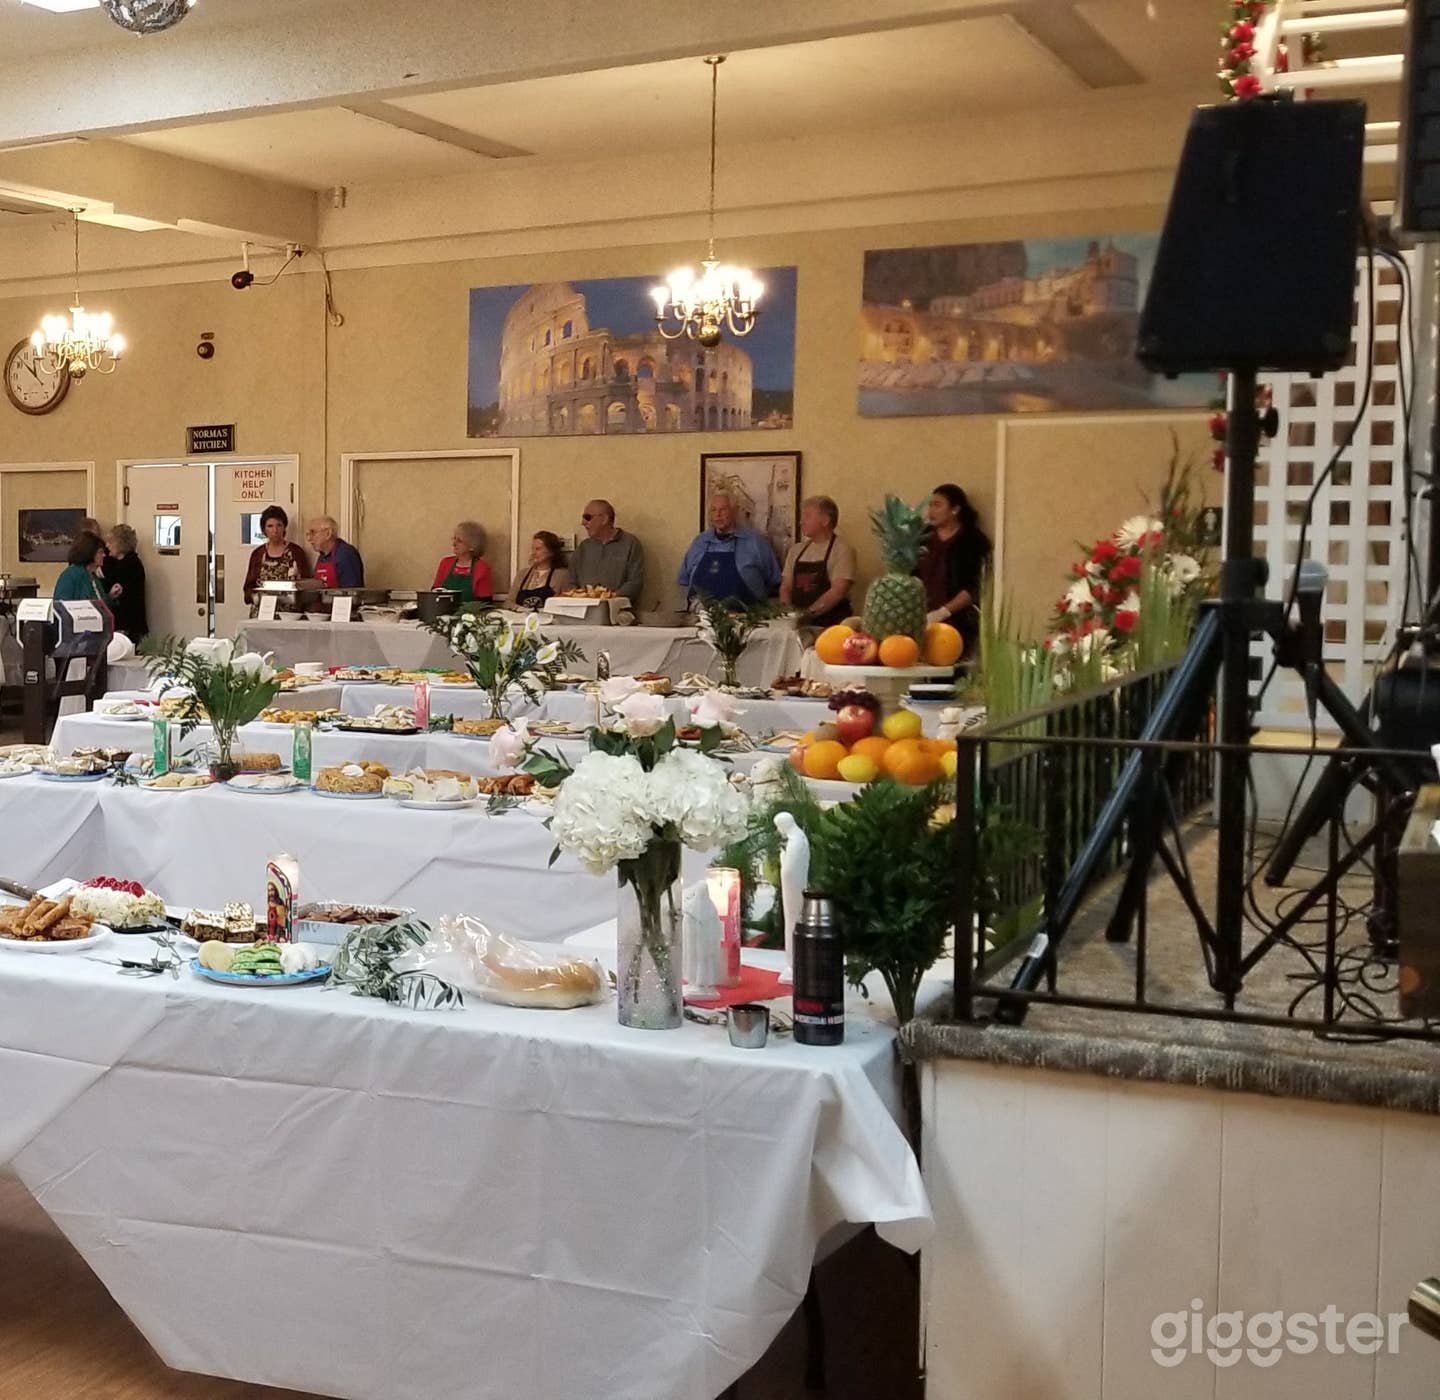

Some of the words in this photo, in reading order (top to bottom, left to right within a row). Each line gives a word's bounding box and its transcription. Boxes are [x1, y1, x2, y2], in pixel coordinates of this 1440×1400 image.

[193, 439, 228, 450] KITCHEN
[234, 469, 273, 479] KITCHEN
[242, 480, 265, 489] HELP
[241, 491, 265, 499] ONLY
